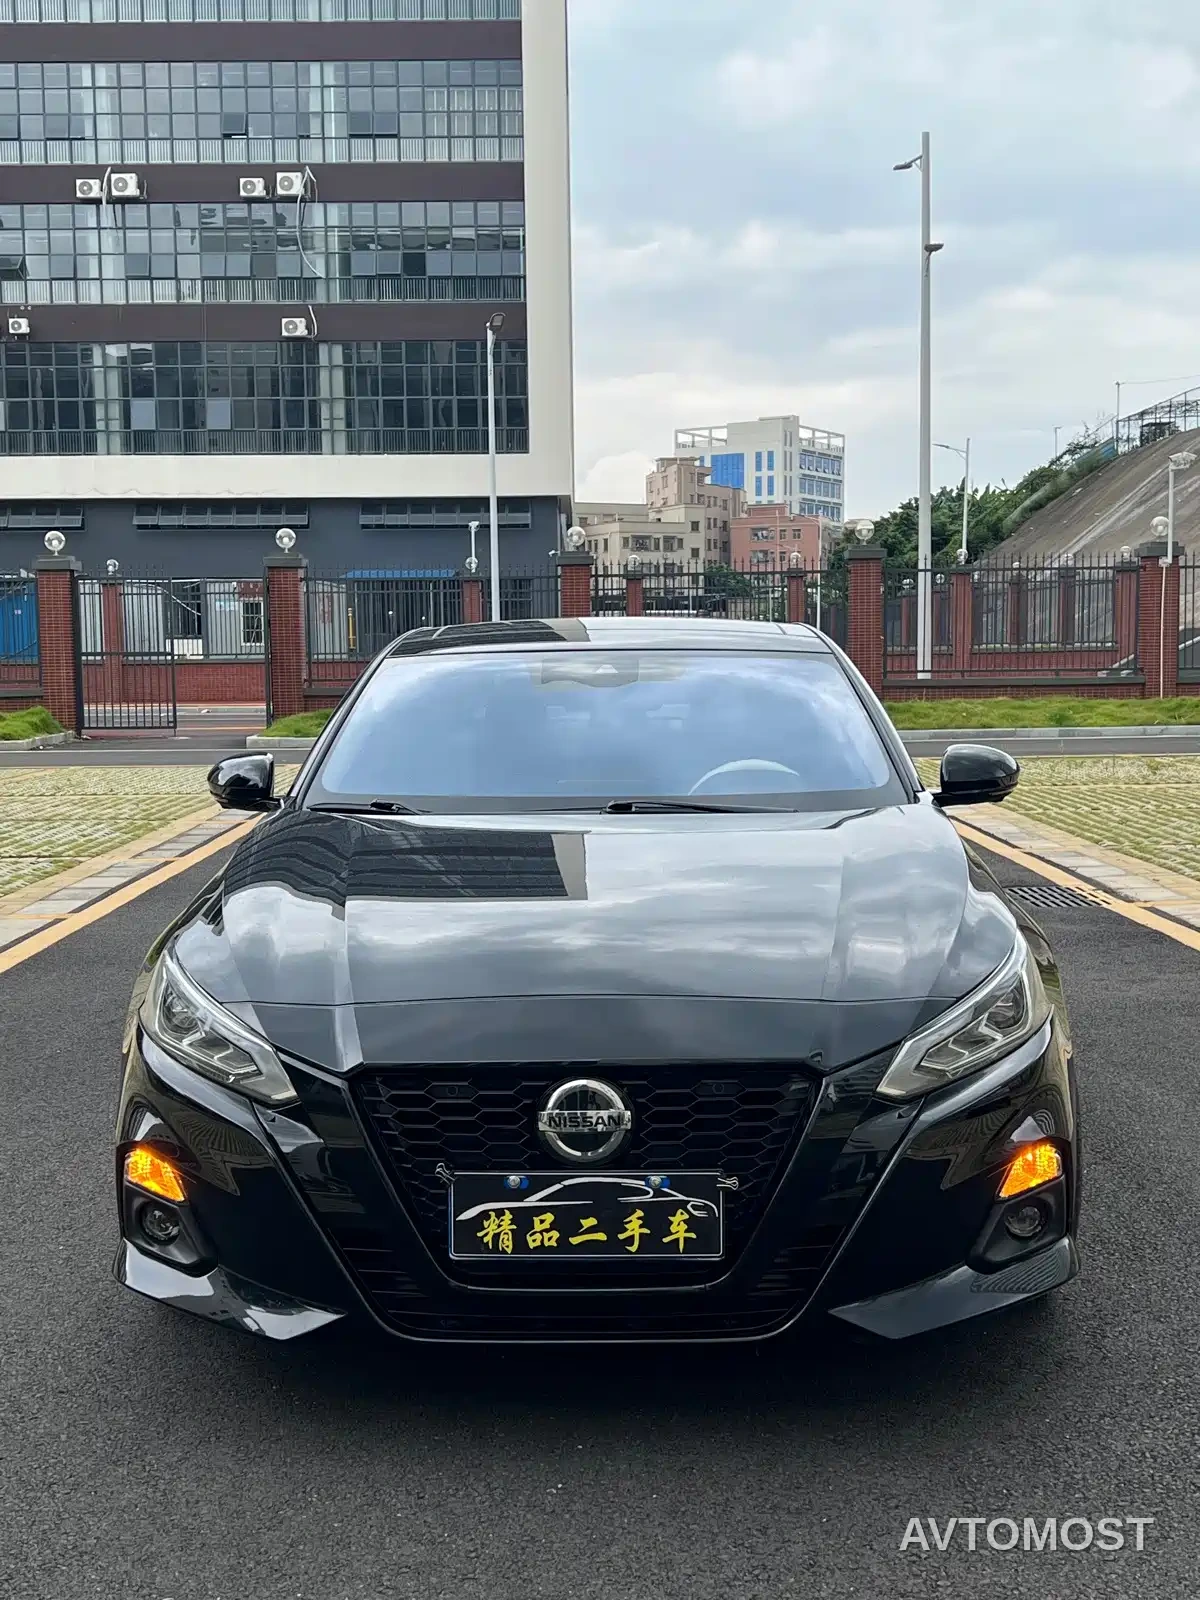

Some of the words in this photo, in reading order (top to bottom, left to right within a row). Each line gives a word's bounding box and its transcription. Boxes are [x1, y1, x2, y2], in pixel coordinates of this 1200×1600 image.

[548, 1114, 621, 1129] NISSAN
[476, 1208, 698, 1254] 精品二手车
